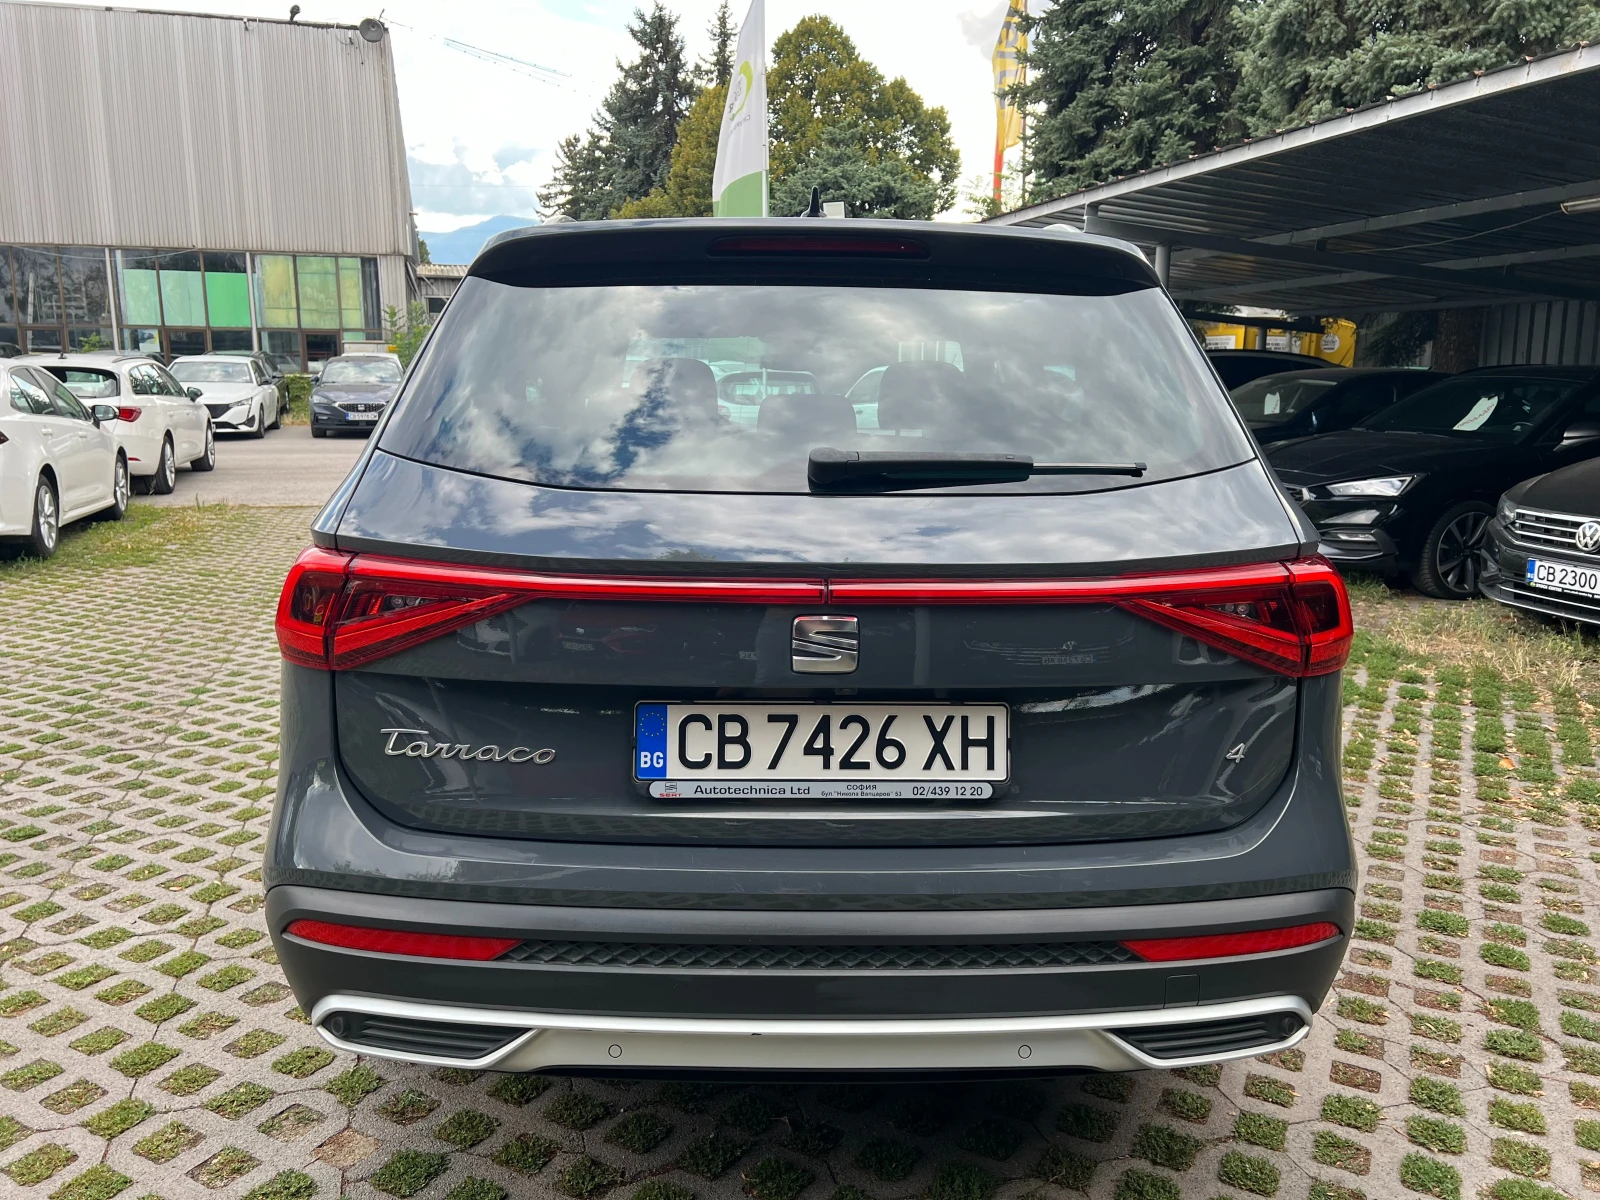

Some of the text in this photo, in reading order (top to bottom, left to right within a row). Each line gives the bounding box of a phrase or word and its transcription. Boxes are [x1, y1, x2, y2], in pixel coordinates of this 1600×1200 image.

[1537, 564, 1598, 590] CB 2300
[380, 728, 556, 765] Tarraco
[677, 713, 996, 772] CB 7426 XH
[1225, 742, 1246, 764] 4
[640, 752, 664, 768] BG
[693, 785, 811, 795] Autotechnica Ltd
[912, 785, 983, 797] 02/439 12 20
